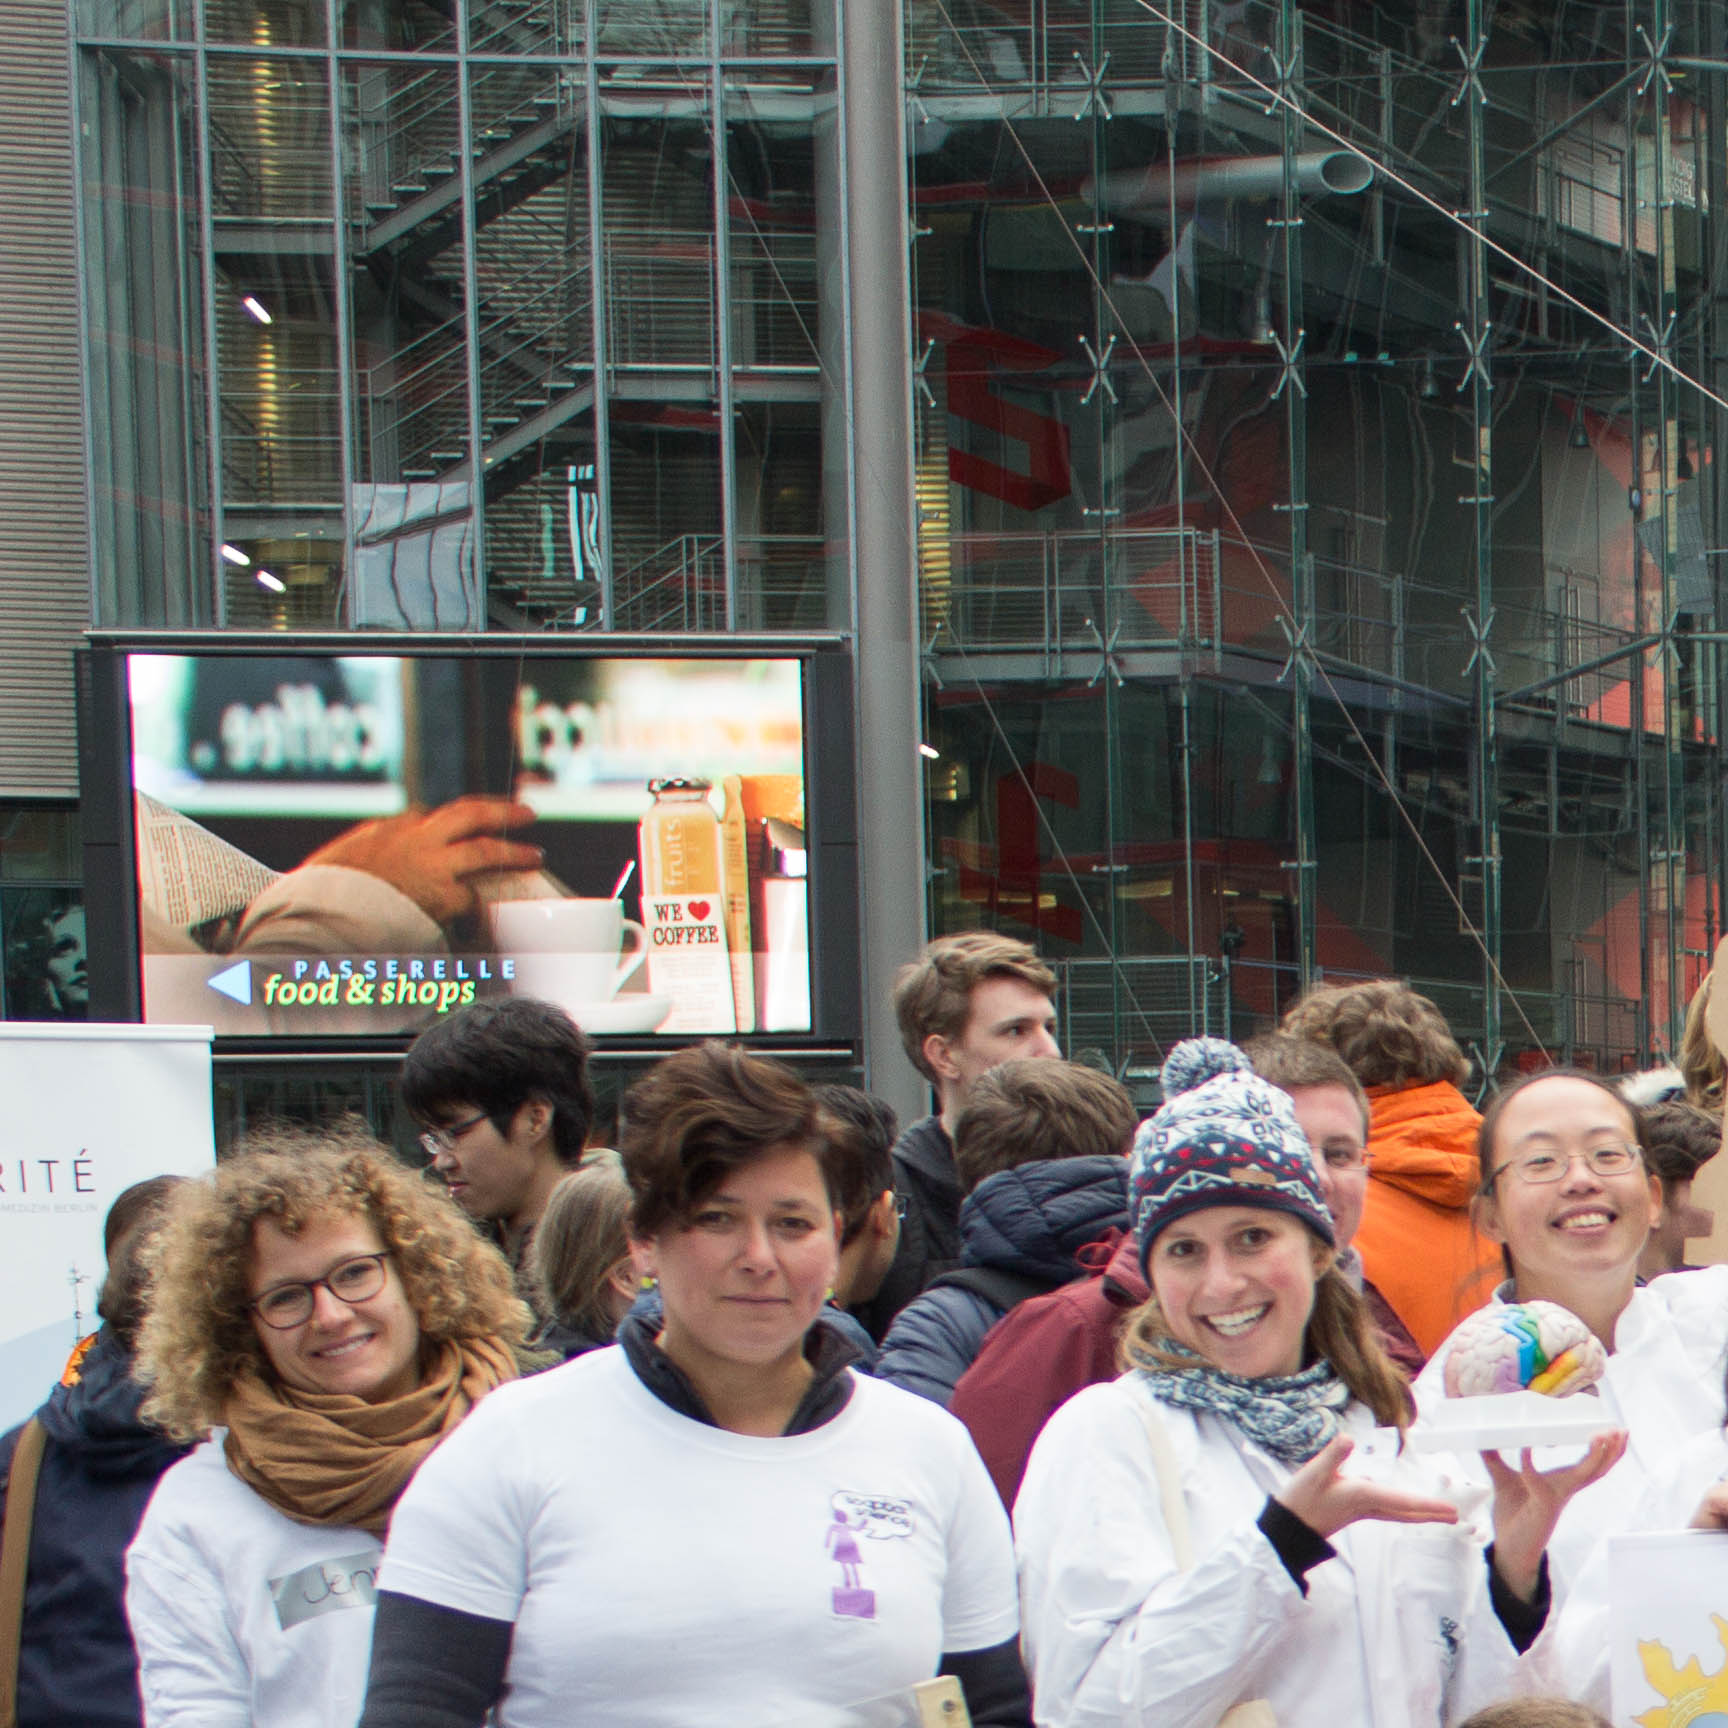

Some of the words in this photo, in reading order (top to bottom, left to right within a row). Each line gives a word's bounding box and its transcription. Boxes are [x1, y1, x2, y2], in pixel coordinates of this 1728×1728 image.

[655, 903, 683, 922] WE
[653, 925, 720, 945] COFFEE
[294, 959, 516, 980] PASSERELLE
[264, 973, 341, 1006] food
[344, 973, 377, 1006] &
[380, 973, 476, 1013] shops
[0, 1148, 96, 1193] ITÉ
